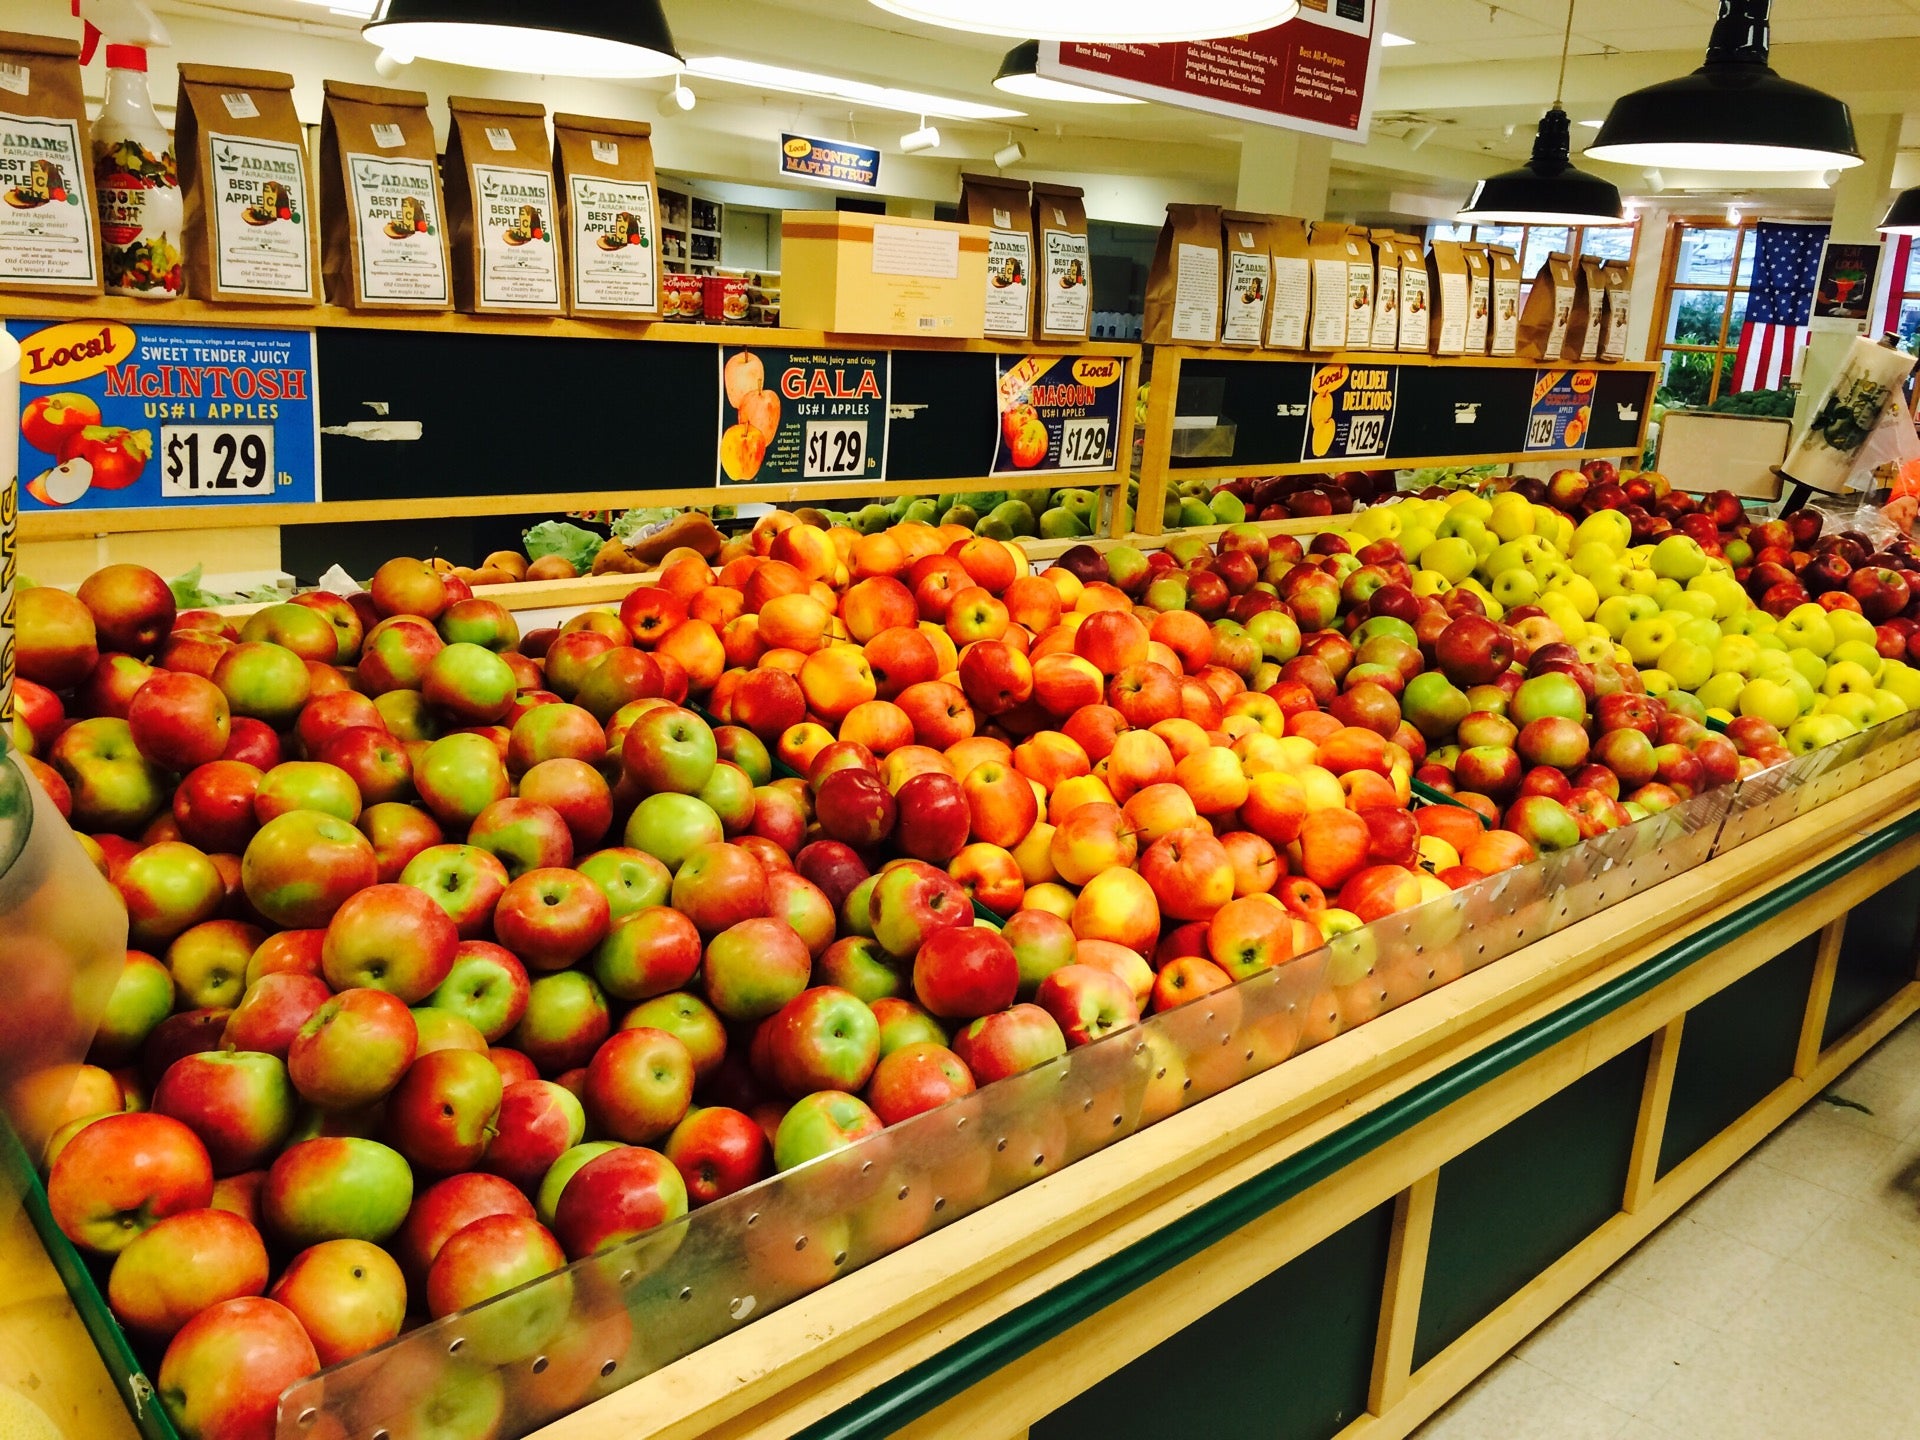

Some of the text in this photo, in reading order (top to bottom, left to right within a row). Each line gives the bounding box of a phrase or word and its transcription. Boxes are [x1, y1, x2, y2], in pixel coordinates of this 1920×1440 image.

[1075, 44, 1111, 62] Rome Beauty
[1299, 46, 1346, 67] Best All-Purpose
[1185, 70, 1196, 80] Pink
[1209, 76, 1219, 85] Red
[3, 133, 69, 153] ADAMS
[788, 142, 807, 152] Local
[4, 147, 71, 162] FAIRACRE FARMS
[812, 147, 859, 167] HONEY
[241, 156, 296, 174] ADAMS
[786, 157, 873, 183] MAPLE SYRUP
[229, 178, 259, 191] BEST
[381, 174, 429, 190] ADAMS
[225, 192, 264, 205] APPLE
[501, 184, 546, 198] ADAMS
[371, 196, 398, 207] BEST
[368, 209, 403, 220] APPLE
[491, 204, 517, 215] BEST
[588, 211, 614, 221] BEST
[488, 217, 521, 228] APPLE
[584, 223, 617, 233] APPLE
[994, 241, 1026, 253] ADAMS
[1061, 244, 1085, 253] ADAMS
[1054, 258, 1069, 266] BEST
[1052, 267, 1070, 275] APPLE
[170, 337, 184, 345] pies,
[26, 327, 116, 375] Local
[141, 346, 290, 364] SWEET TENDER JUICY
[789, 354, 876, 366] Sweet, Mild, Juicy and Crisp
[1000, 356, 1040, 396] SALE
[1079, 362, 1114, 377] Local
[1318, 366, 1343, 388] Local
[104, 364, 308, 400] McINTOSH
[781, 367, 882, 400] GALA
[1350, 370, 1389, 390] GOLDEN
[1574, 376, 1592, 387] Local
[1031, 384, 1096, 407] MACOUN
[1342, 391, 1392, 411] DELICIOUS
[144, 402, 279, 419] US#1 APPLES
[798, 403, 870, 415] US#1 APPLES
[1061, 408, 1086, 417] APPLES
[808, 430, 862, 473] $1.29
[1066, 427, 1106, 461] $1.29
[167, 433, 267, 490] $1.29
[867, 457, 876, 468] lb
[278, 471, 292, 486] lb
